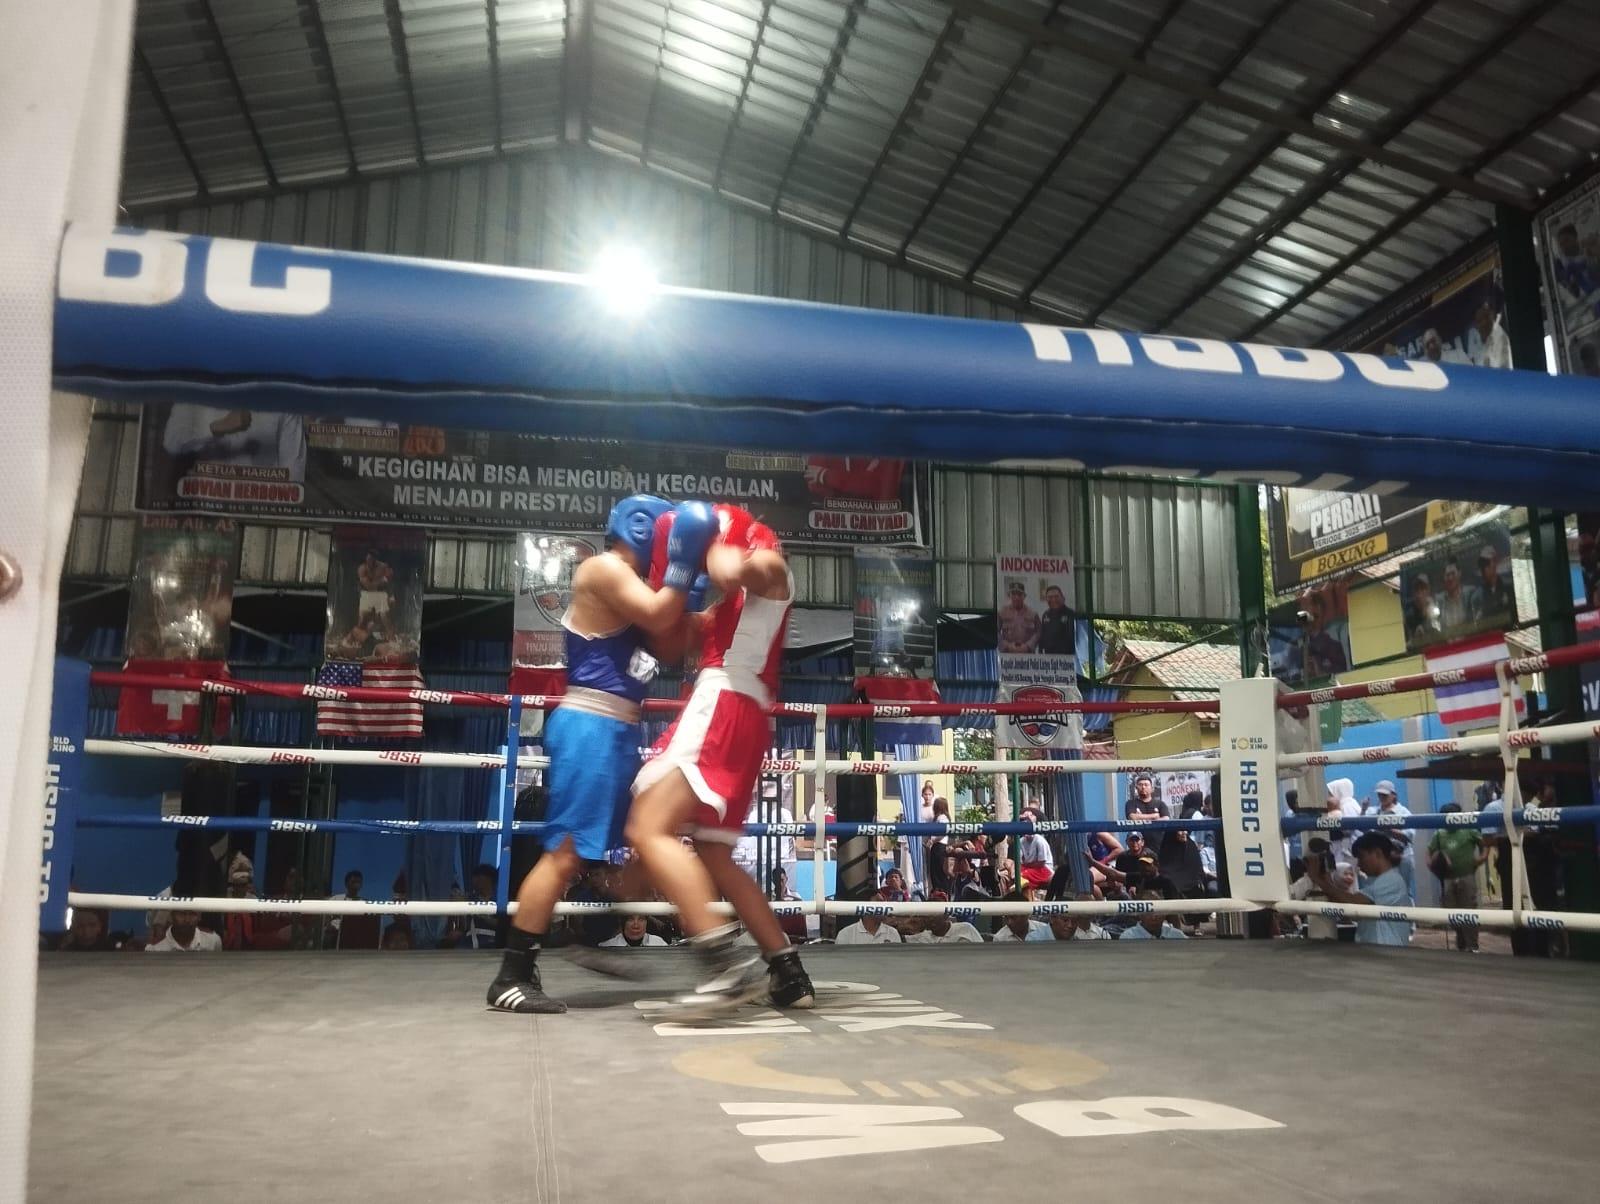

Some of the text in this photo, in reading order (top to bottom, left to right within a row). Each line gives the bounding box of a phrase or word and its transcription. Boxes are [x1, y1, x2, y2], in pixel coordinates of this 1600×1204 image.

[197, 463, 287, 479] KETUA HARIAN
[358, 455, 476, 483] KEGIGIHAN
[483, 463, 530, 486] BISA
[537, 466, 650, 493] MENGUBAH
[656, 472, 780, 501] KEGAGALAN,
[393, 484, 491, 510] MENJADI
[500, 490, 602, 515] PRESTASI
[1310, 493, 1382, 539] PERBATI
[1317, 539, 1376, 572] BOXING
[1001, 557, 1069, 574] INDONESIA
[304, 684, 348, 701] HSBC
[409, 688, 454, 705] HSBC
[873, 705, 911, 717] HSBC
[379, 750, 422, 765] HSBC
[761, 760, 801, 772] HSBC
[852, 762, 890, 774] HSBC
[940, 765, 977, 775] HSBC
[1240, 761, 1261, 833] HSBC
[1377, 814, 1406, 825] HSBC
[1446, 813, 1478, 825] HSBC
[1523, 807, 1562, 822] HSBC
[946, 823, 983, 834] HSBC
[1032, 820, 1069, 832] HSBC
[1316, 817, 1342, 828] HSBC
[767, 824, 806, 835] HSBC
[857, 825, 896, 836] HSBC
[856, 905, 894, 917] HSBC
[944, 906, 981, 917] HSBC
[1032, 904, 1069, 915] HSBC
[1118, 902, 1154, 913] HSBC
[1449, 913, 1481, 927] HSBC
